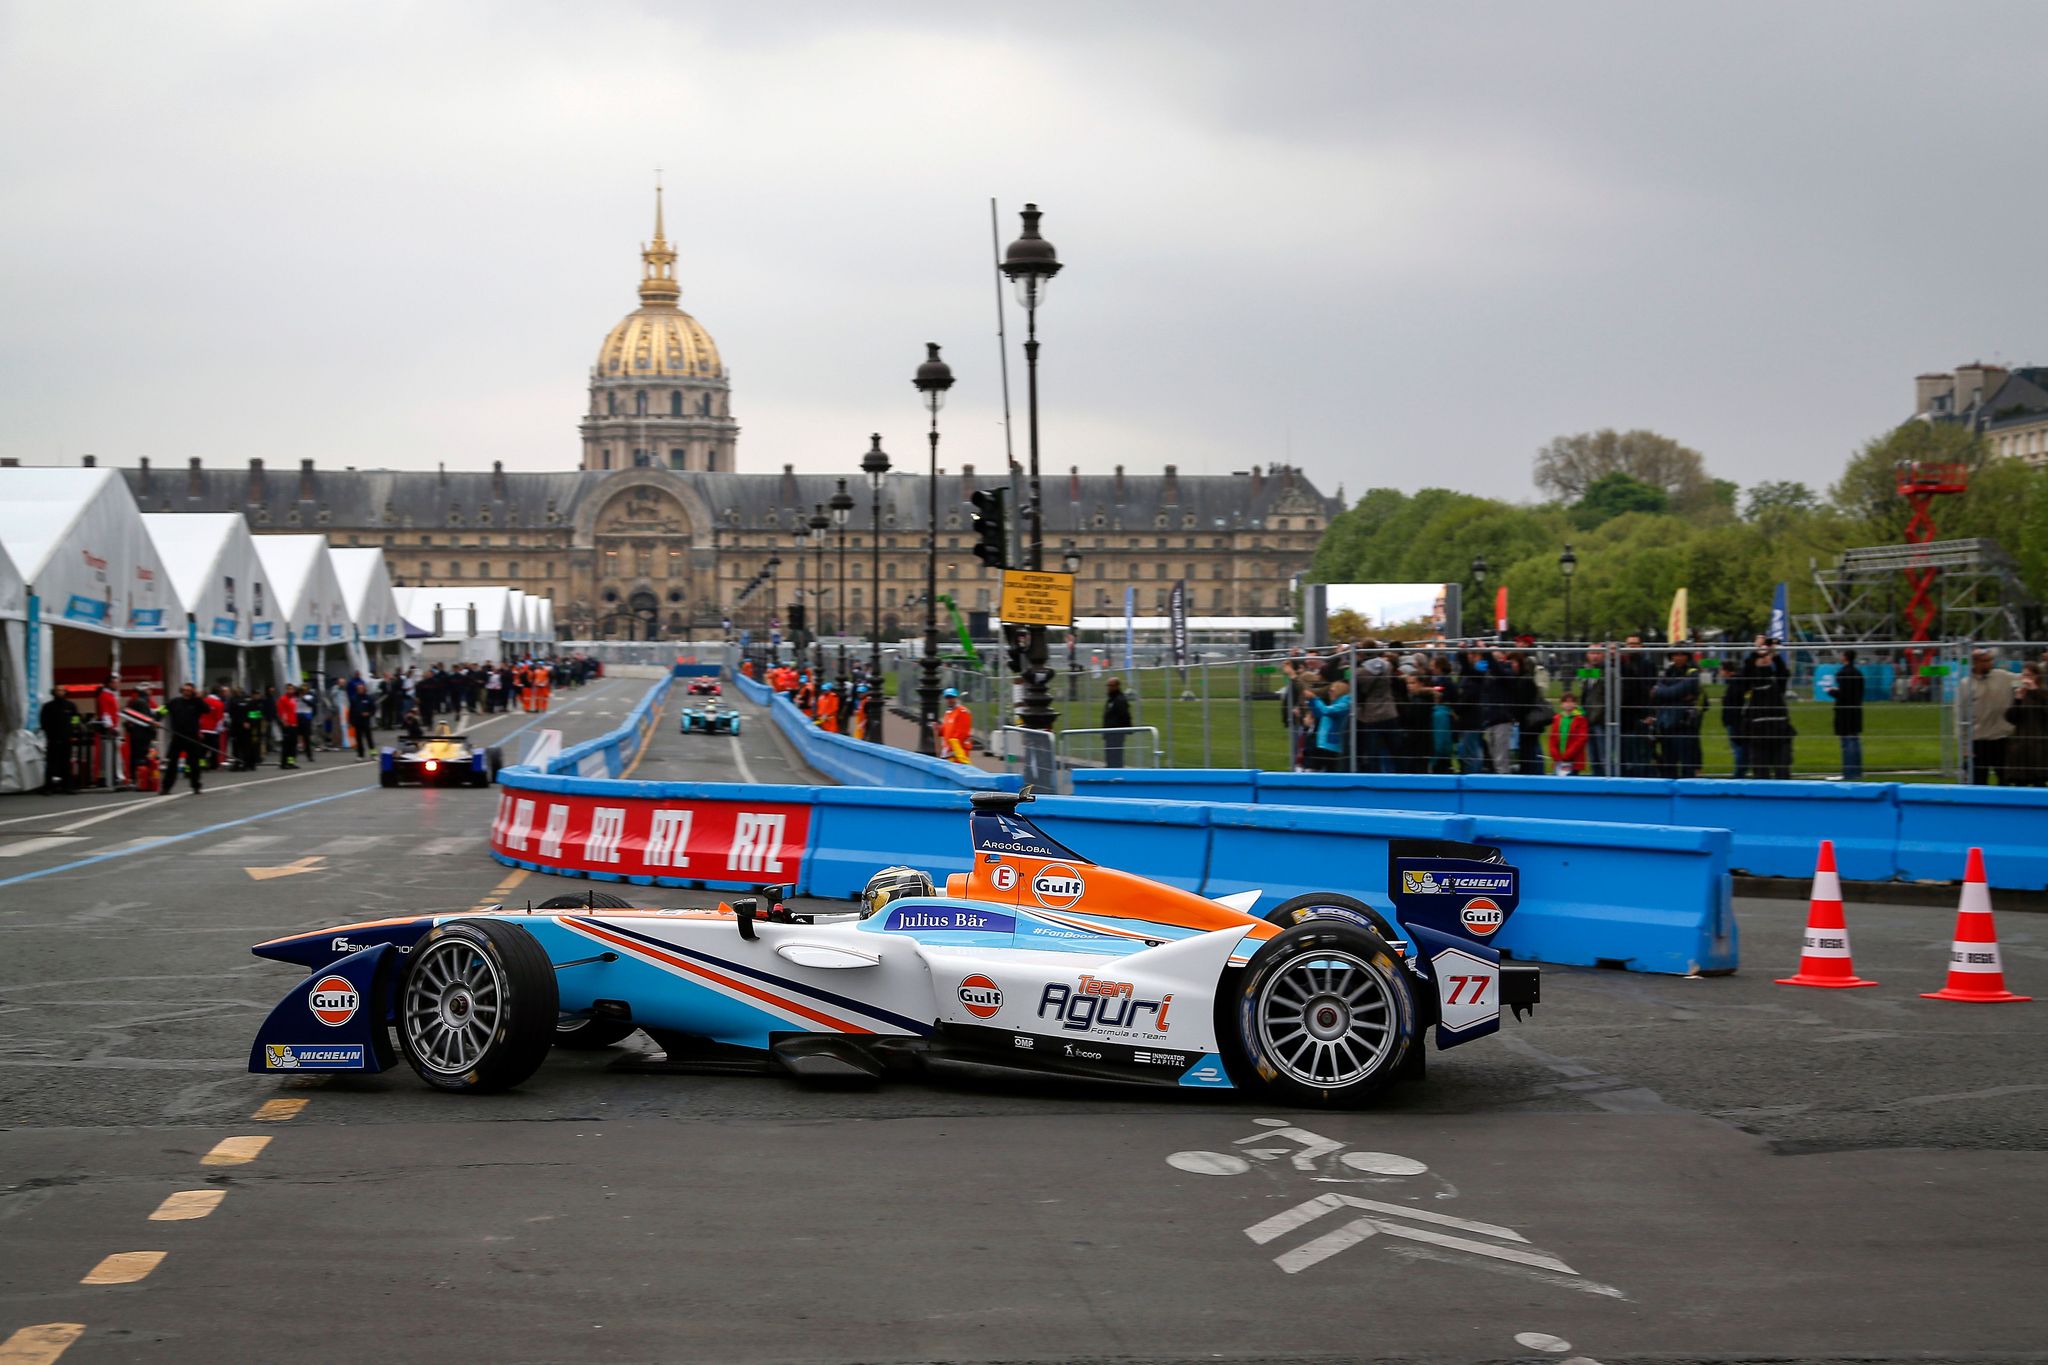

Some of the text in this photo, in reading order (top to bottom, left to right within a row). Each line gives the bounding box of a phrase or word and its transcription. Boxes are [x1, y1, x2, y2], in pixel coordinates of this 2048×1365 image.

[583, 806, 626, 863] RTL
[643, 809, 694, 868] RTL
[727, 812, 787, 873] RTL
[998, 869, 1010, 886] E
[1035, 879, 1080, 894] Gulf
[898, 912, 988, 930] Julius Bär
[1463, 911, 1500, 922] Gulf
[1078, 974, 1134, 999] Team
[1447, 976, 1491, 1005] 77
[312, 993, 355, 1008] Gulf
[959, 988, 1001, 1005] Gulf
[1037, 982, 1174, 1032] Aguri
[1090, 1027, 1130, 1037] Formula
[1142, 1032, 1168, 1041] Team
[1014, 1038, 1034, 1048] OMP
[299, 1051, 360, 1060] MICHELIN
[1151, 1059, 1185, 1067] CAPITAL
[1152, 1053, 1186, 1062] INNOVATOR
